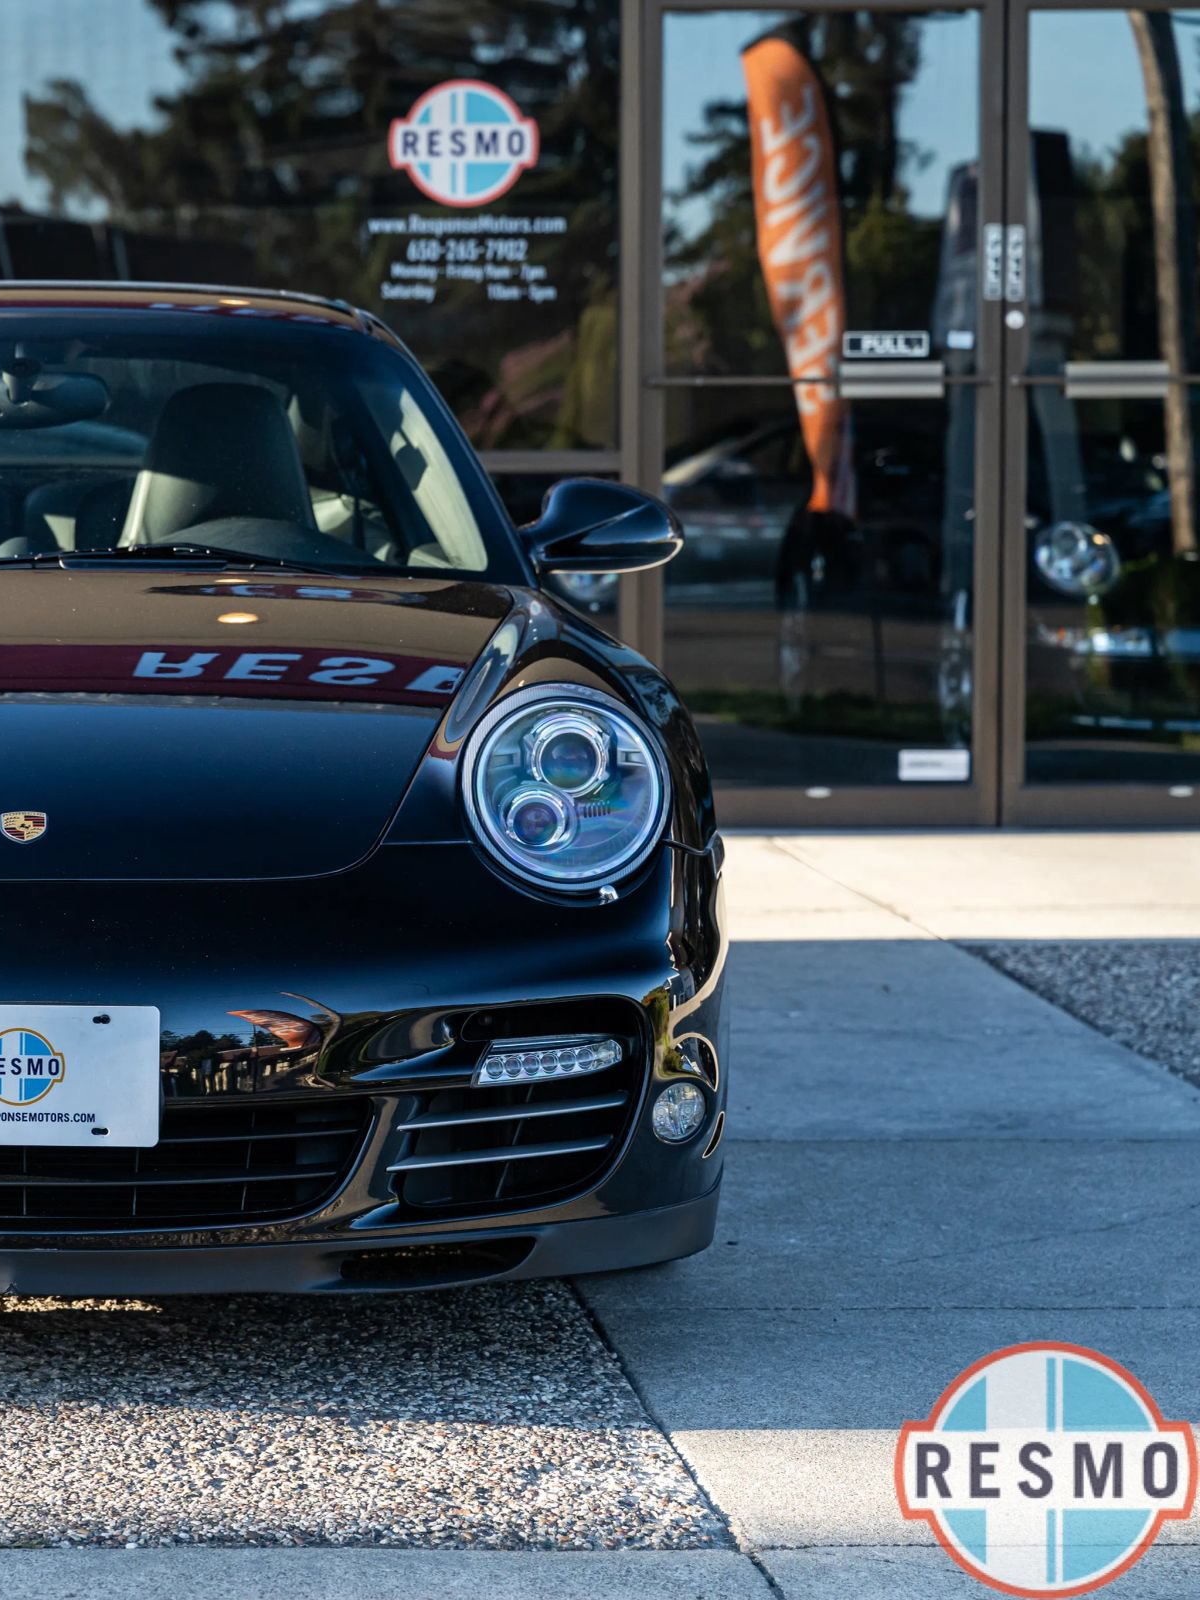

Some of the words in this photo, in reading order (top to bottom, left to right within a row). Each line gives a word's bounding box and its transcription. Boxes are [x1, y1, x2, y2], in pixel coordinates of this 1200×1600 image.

[402, 130, 525, 157] RESMO
[381, 281, 436, 303] Saturday
[861, 334, 907, 353] PULL
